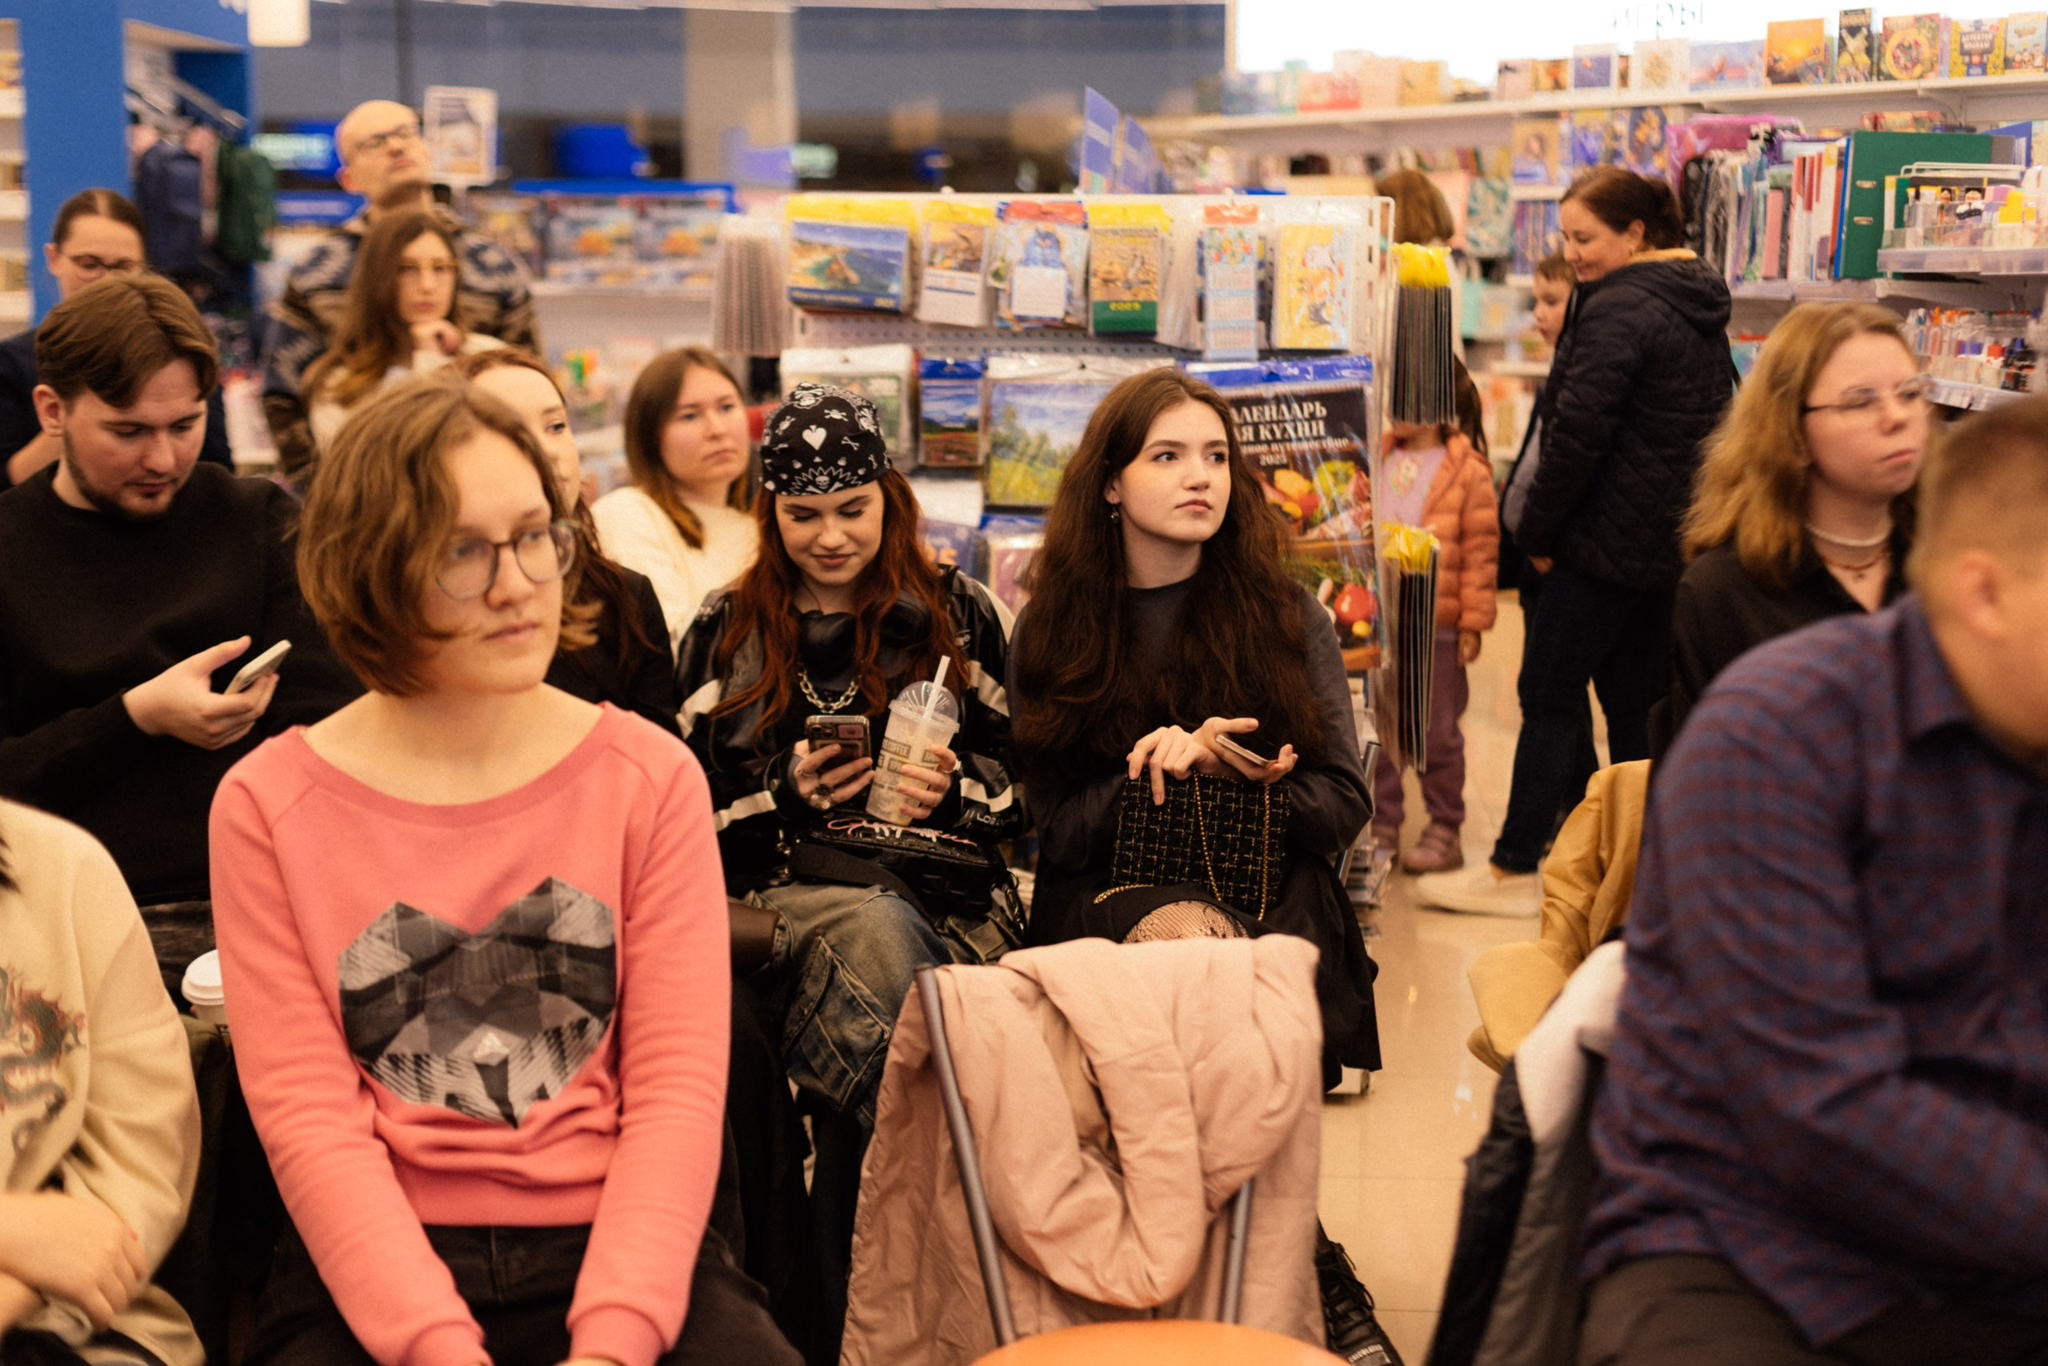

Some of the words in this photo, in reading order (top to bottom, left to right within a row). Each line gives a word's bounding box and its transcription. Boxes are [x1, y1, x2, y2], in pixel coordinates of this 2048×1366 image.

[1229, 401, 1327, 423] АЛЕНДАРЬ
[1233, 424, 1254, 443] ЛЯ
[1258, 420, 1325, 440] КУХНИ
